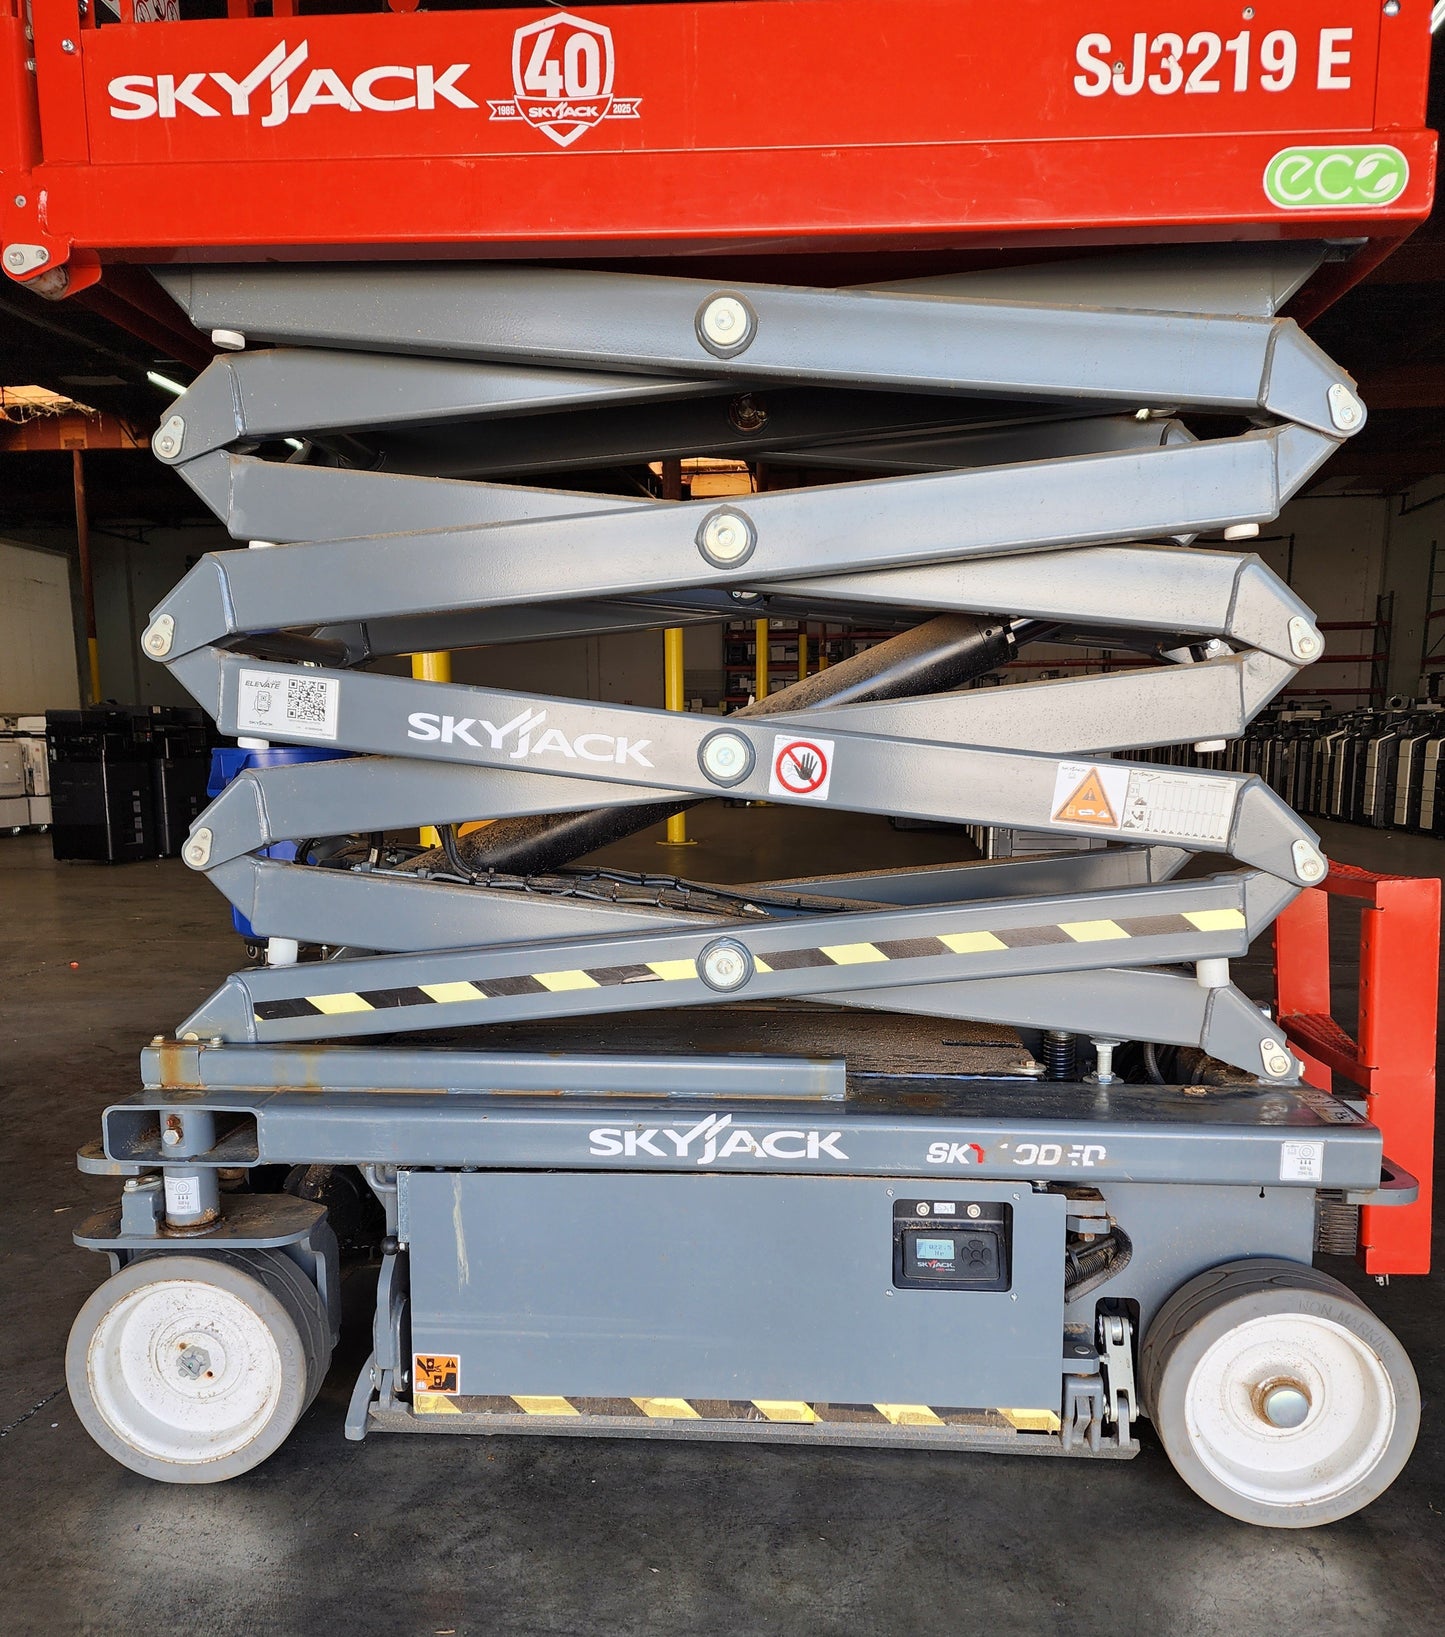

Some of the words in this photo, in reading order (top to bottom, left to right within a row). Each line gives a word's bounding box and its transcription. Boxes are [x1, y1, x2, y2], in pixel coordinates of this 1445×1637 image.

[107, 38, 479, 127] SKYJACK
[524, 28, 600, 98] 40
[1074, 29, 1298, 97] SJ3219
[1317, 27, 1353, 89] E
[497, 105, 515, 116] 1985
[528, 101, 599, 120] SKYJACK
[612, 103, 632, 114] 2025
[245, 678, 281, 690] ELEVATE
[407, 707, 656, 768] SKYJACK
[589, 1113, 849, 1165] SKYJACK
[917, 1260, 953, 1268] SKYJACK
